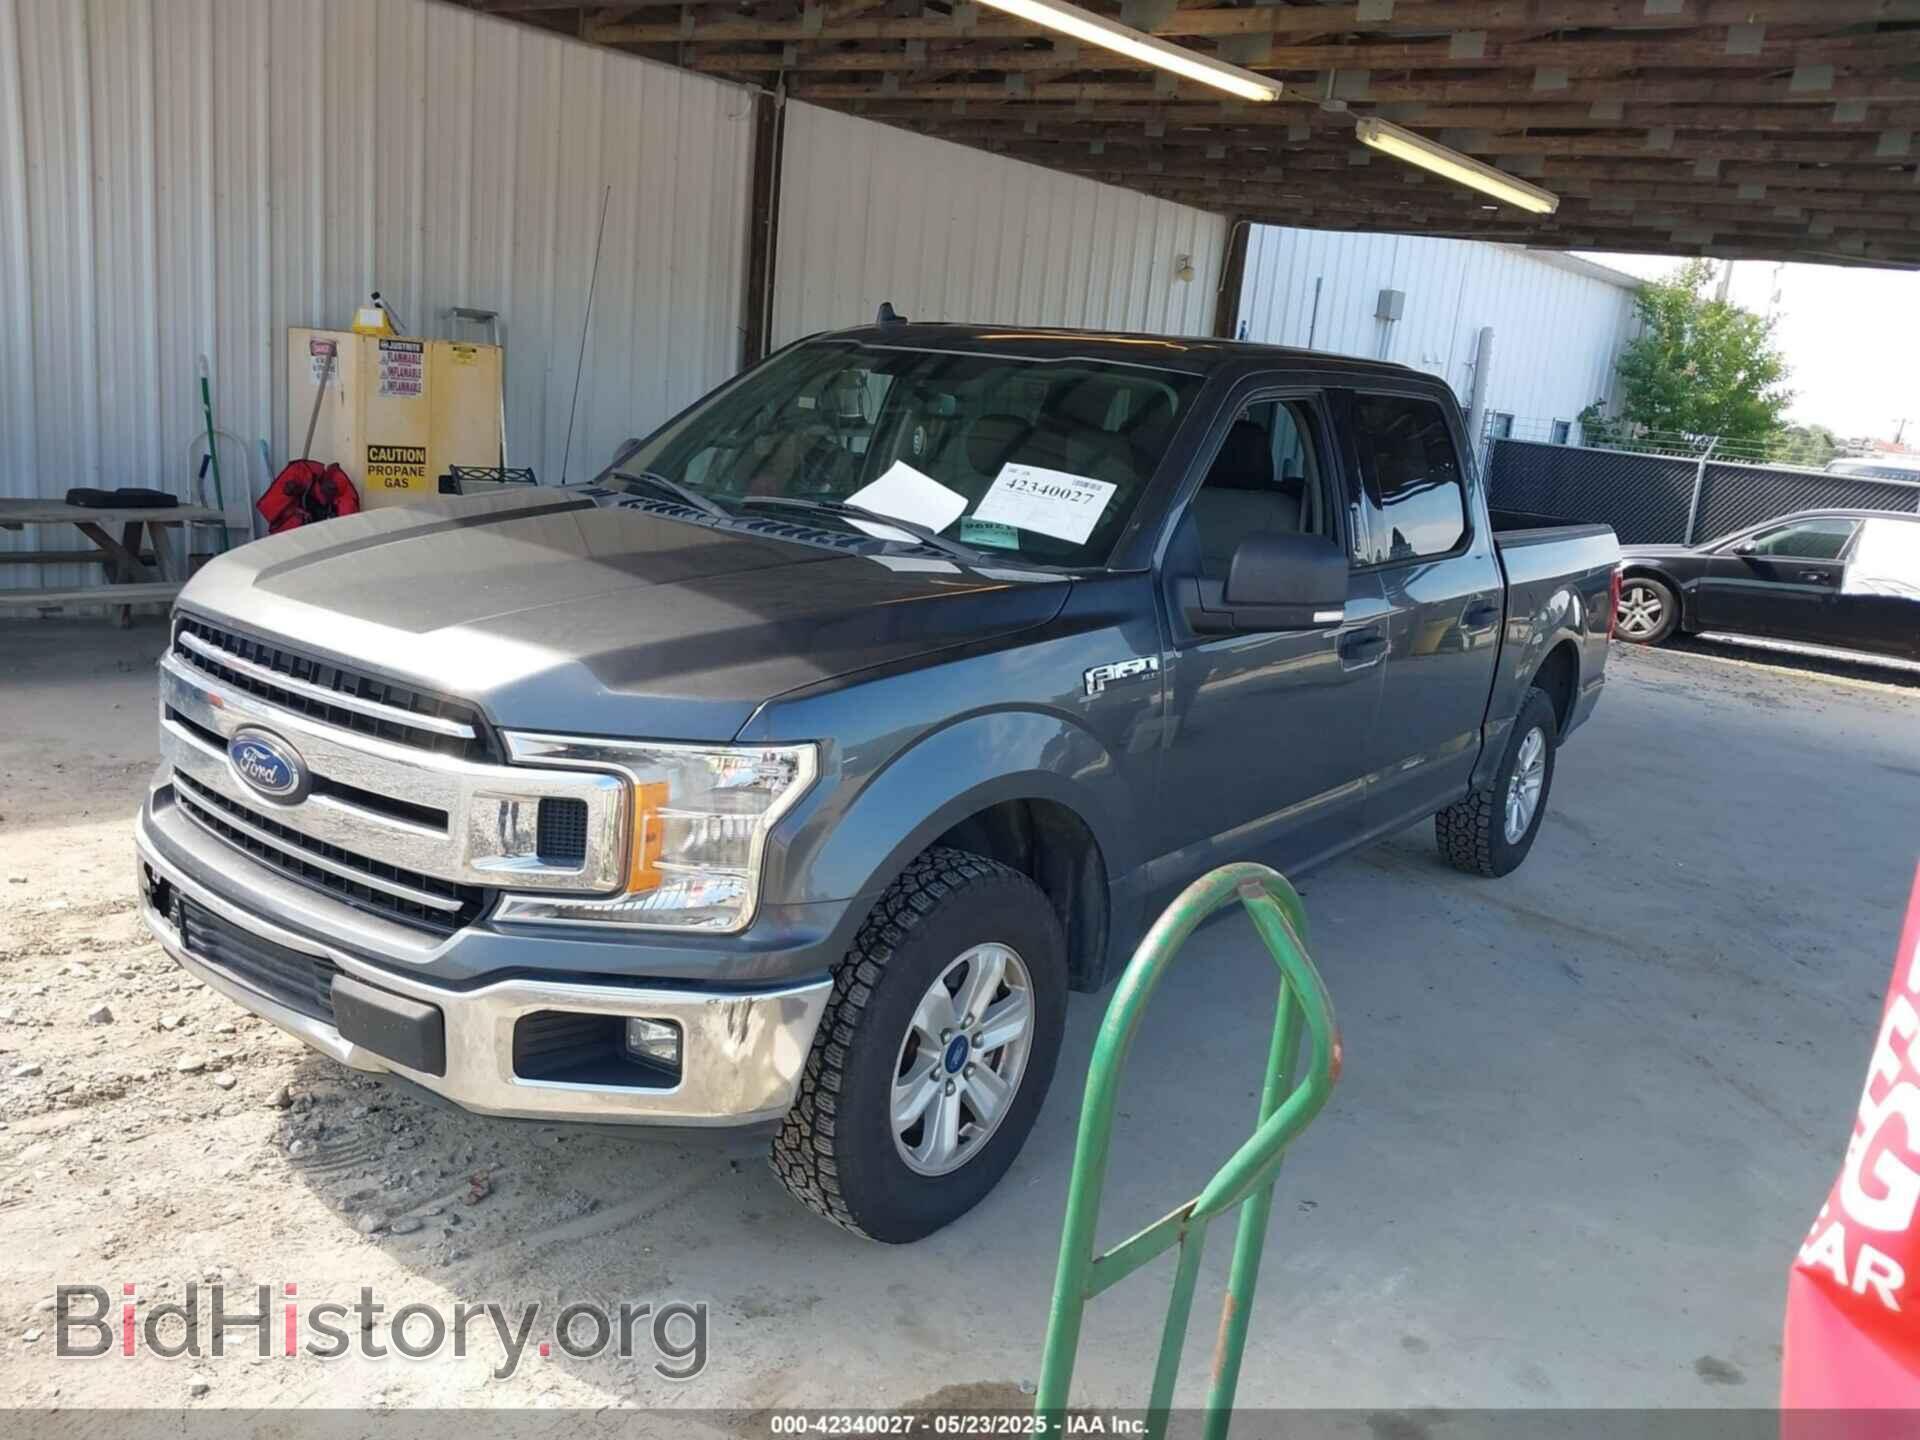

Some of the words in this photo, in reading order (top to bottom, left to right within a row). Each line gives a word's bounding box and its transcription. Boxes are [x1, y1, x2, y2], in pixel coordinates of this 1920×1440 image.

[369, 447, 425, 463] CAUTION
[368, 464, 425, 478] PROPANE
[384, 476, 409, 489] GAS
[1005, 479, 1095, 505] 42340027
[240, 746, 279, 784] Ford
